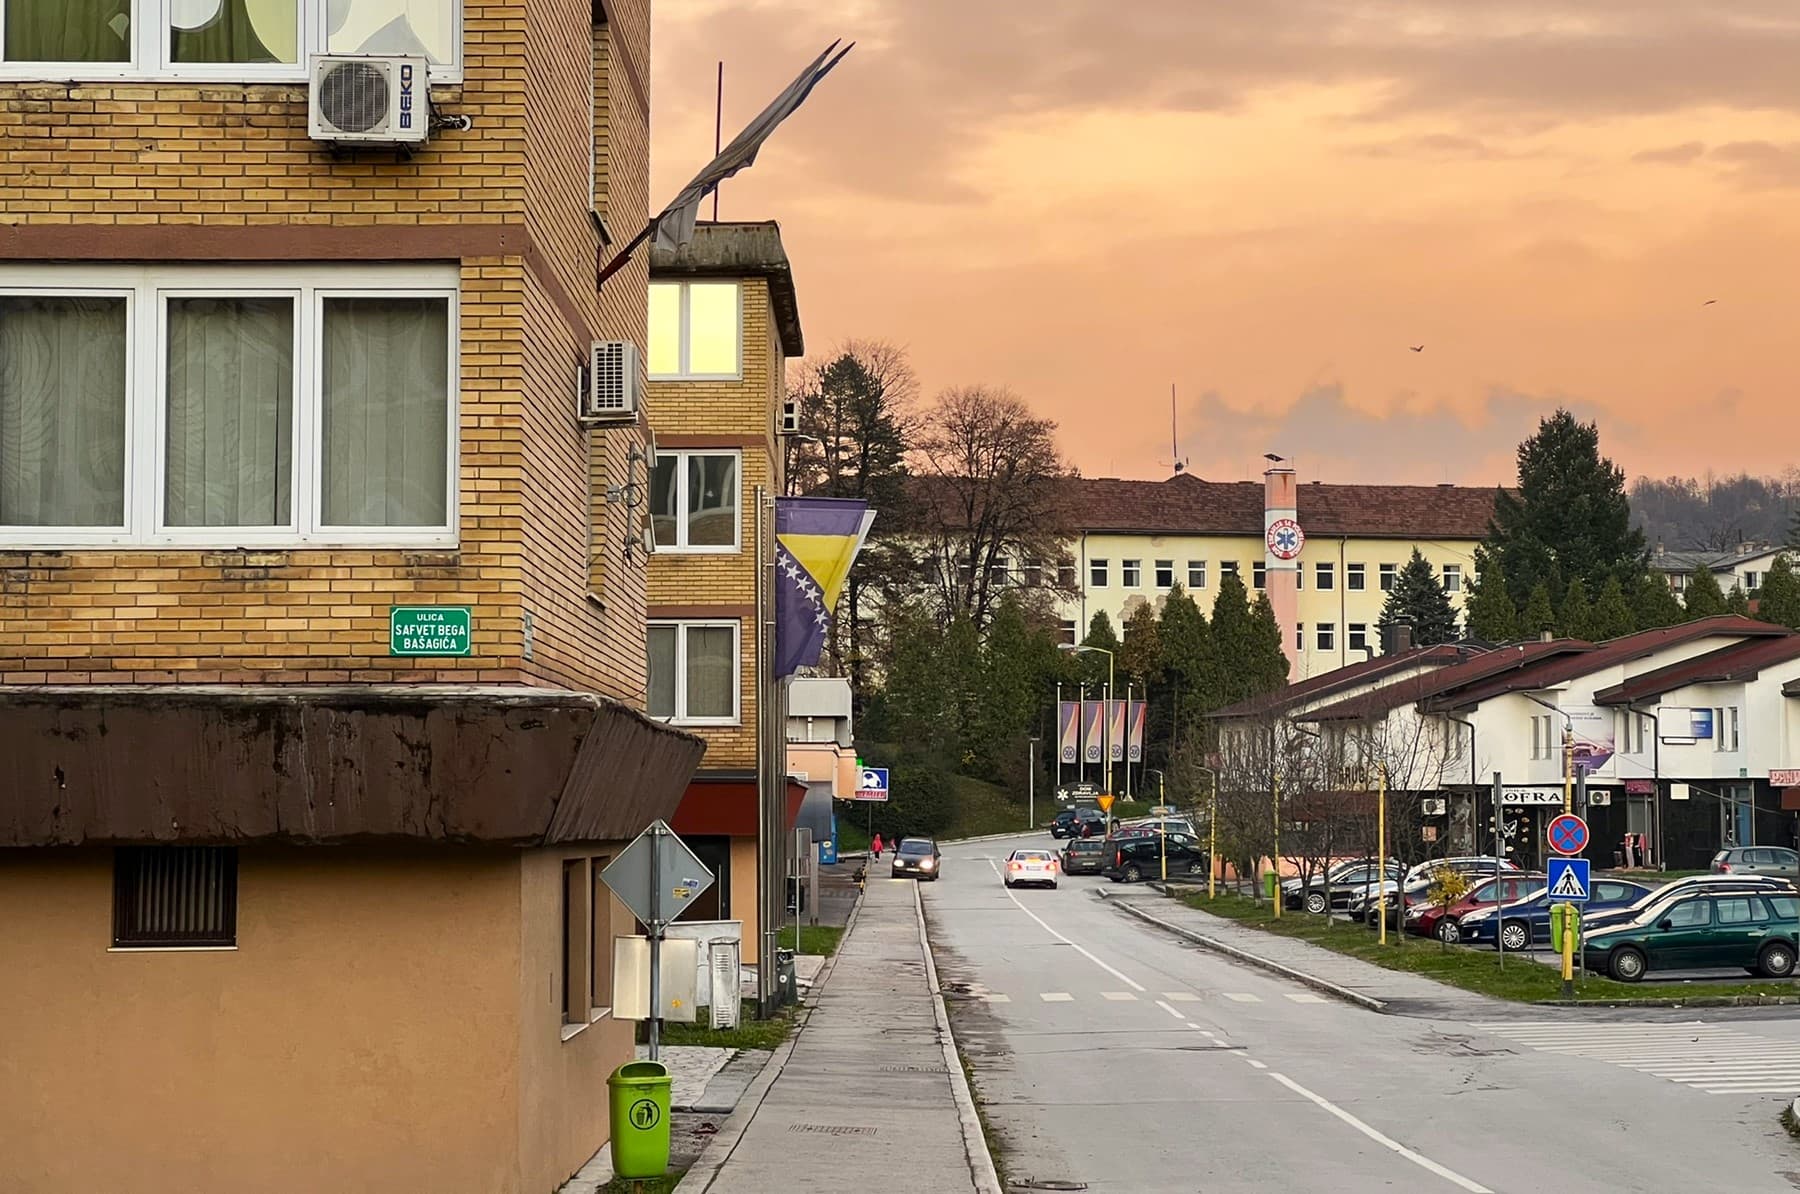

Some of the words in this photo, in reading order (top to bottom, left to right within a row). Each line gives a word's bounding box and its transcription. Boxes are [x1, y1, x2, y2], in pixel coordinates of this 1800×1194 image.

[400, 65, 412, 128] BEKO
[416, 613, 444, 621] ULICA
[395, 624, 436, 636] SAFVET
[438, 624, 466, 636] BEGA
[403, 636, 457, 649] BAŠAGIĆA
[1494, 791, 1562, 802] OFRA
